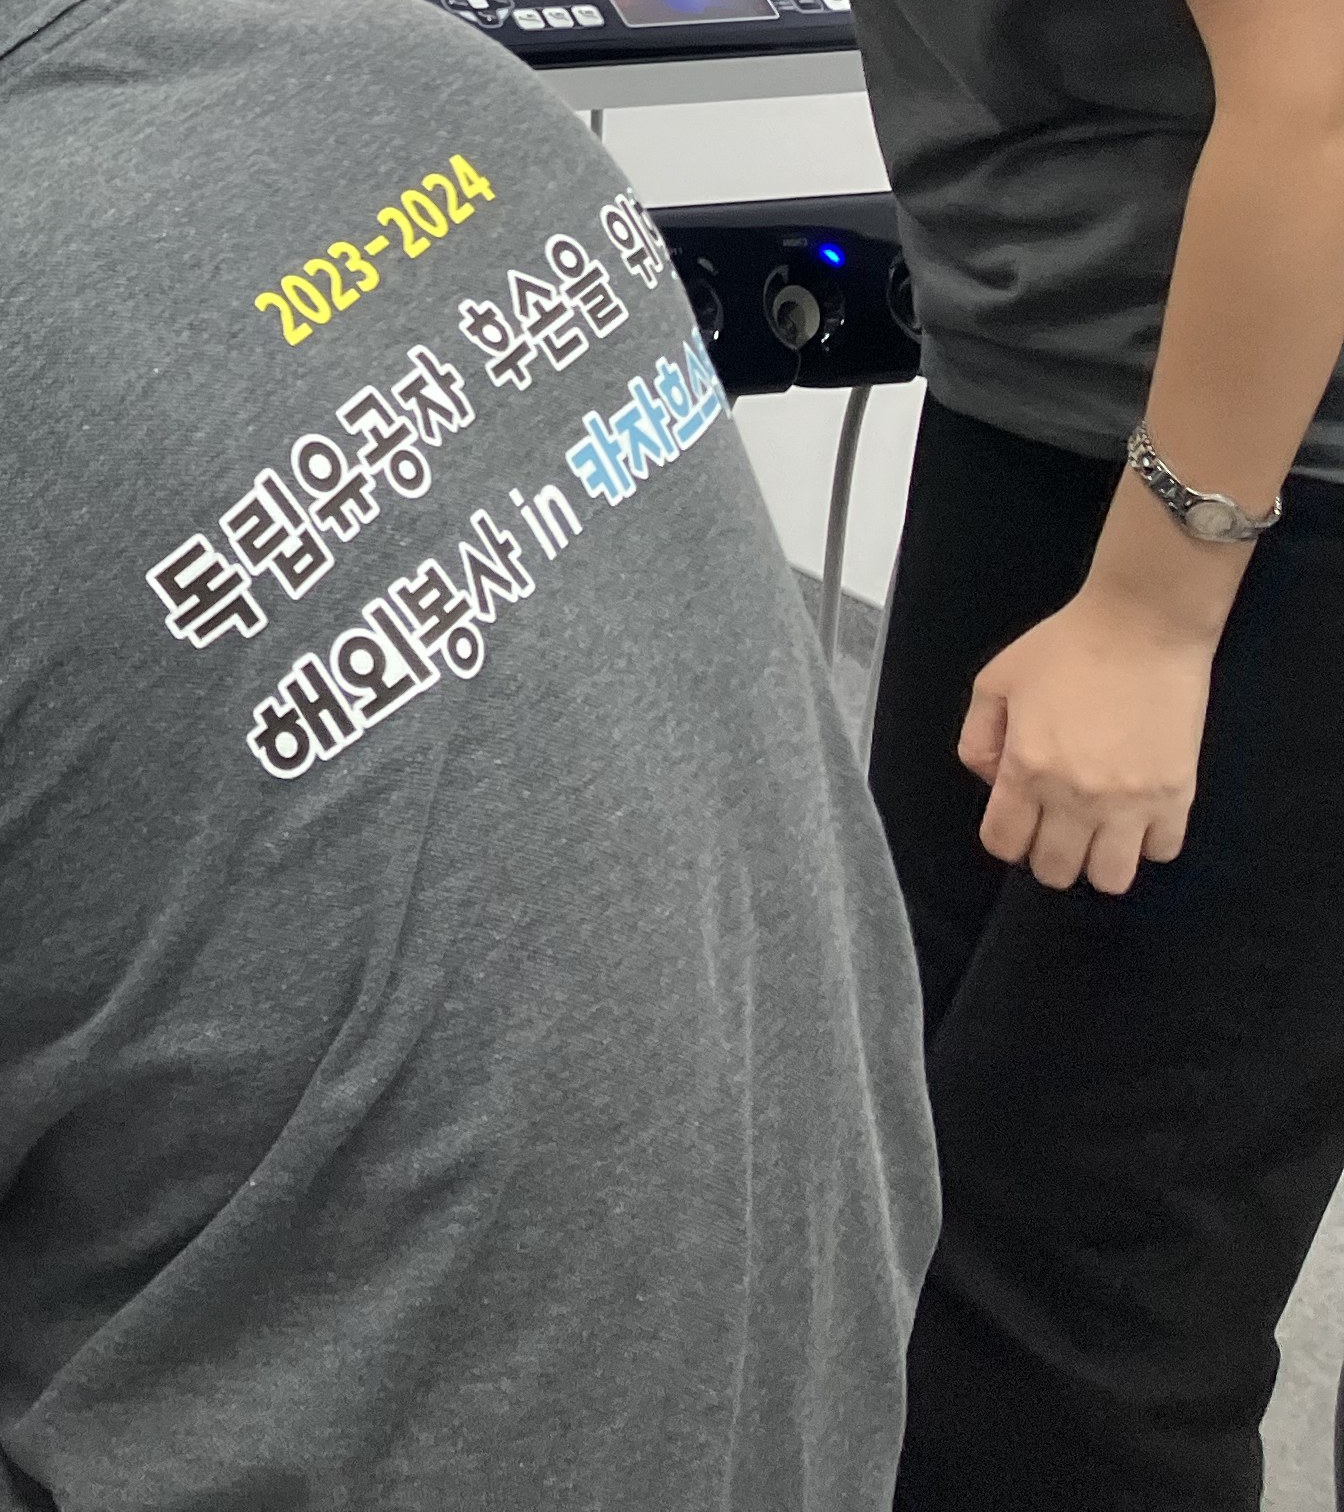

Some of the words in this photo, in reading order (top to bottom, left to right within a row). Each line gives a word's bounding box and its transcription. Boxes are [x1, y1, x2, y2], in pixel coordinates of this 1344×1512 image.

[255, 154, 496, 346] 2023-2024
[146, 344, 476, 649] 독립유공자
[458, 233, 629, 390] 후손을
[599, 189, 667, 290] 위
[247, 509, 536, 779] 해외봉사
[508, 483, 584, 560] in
